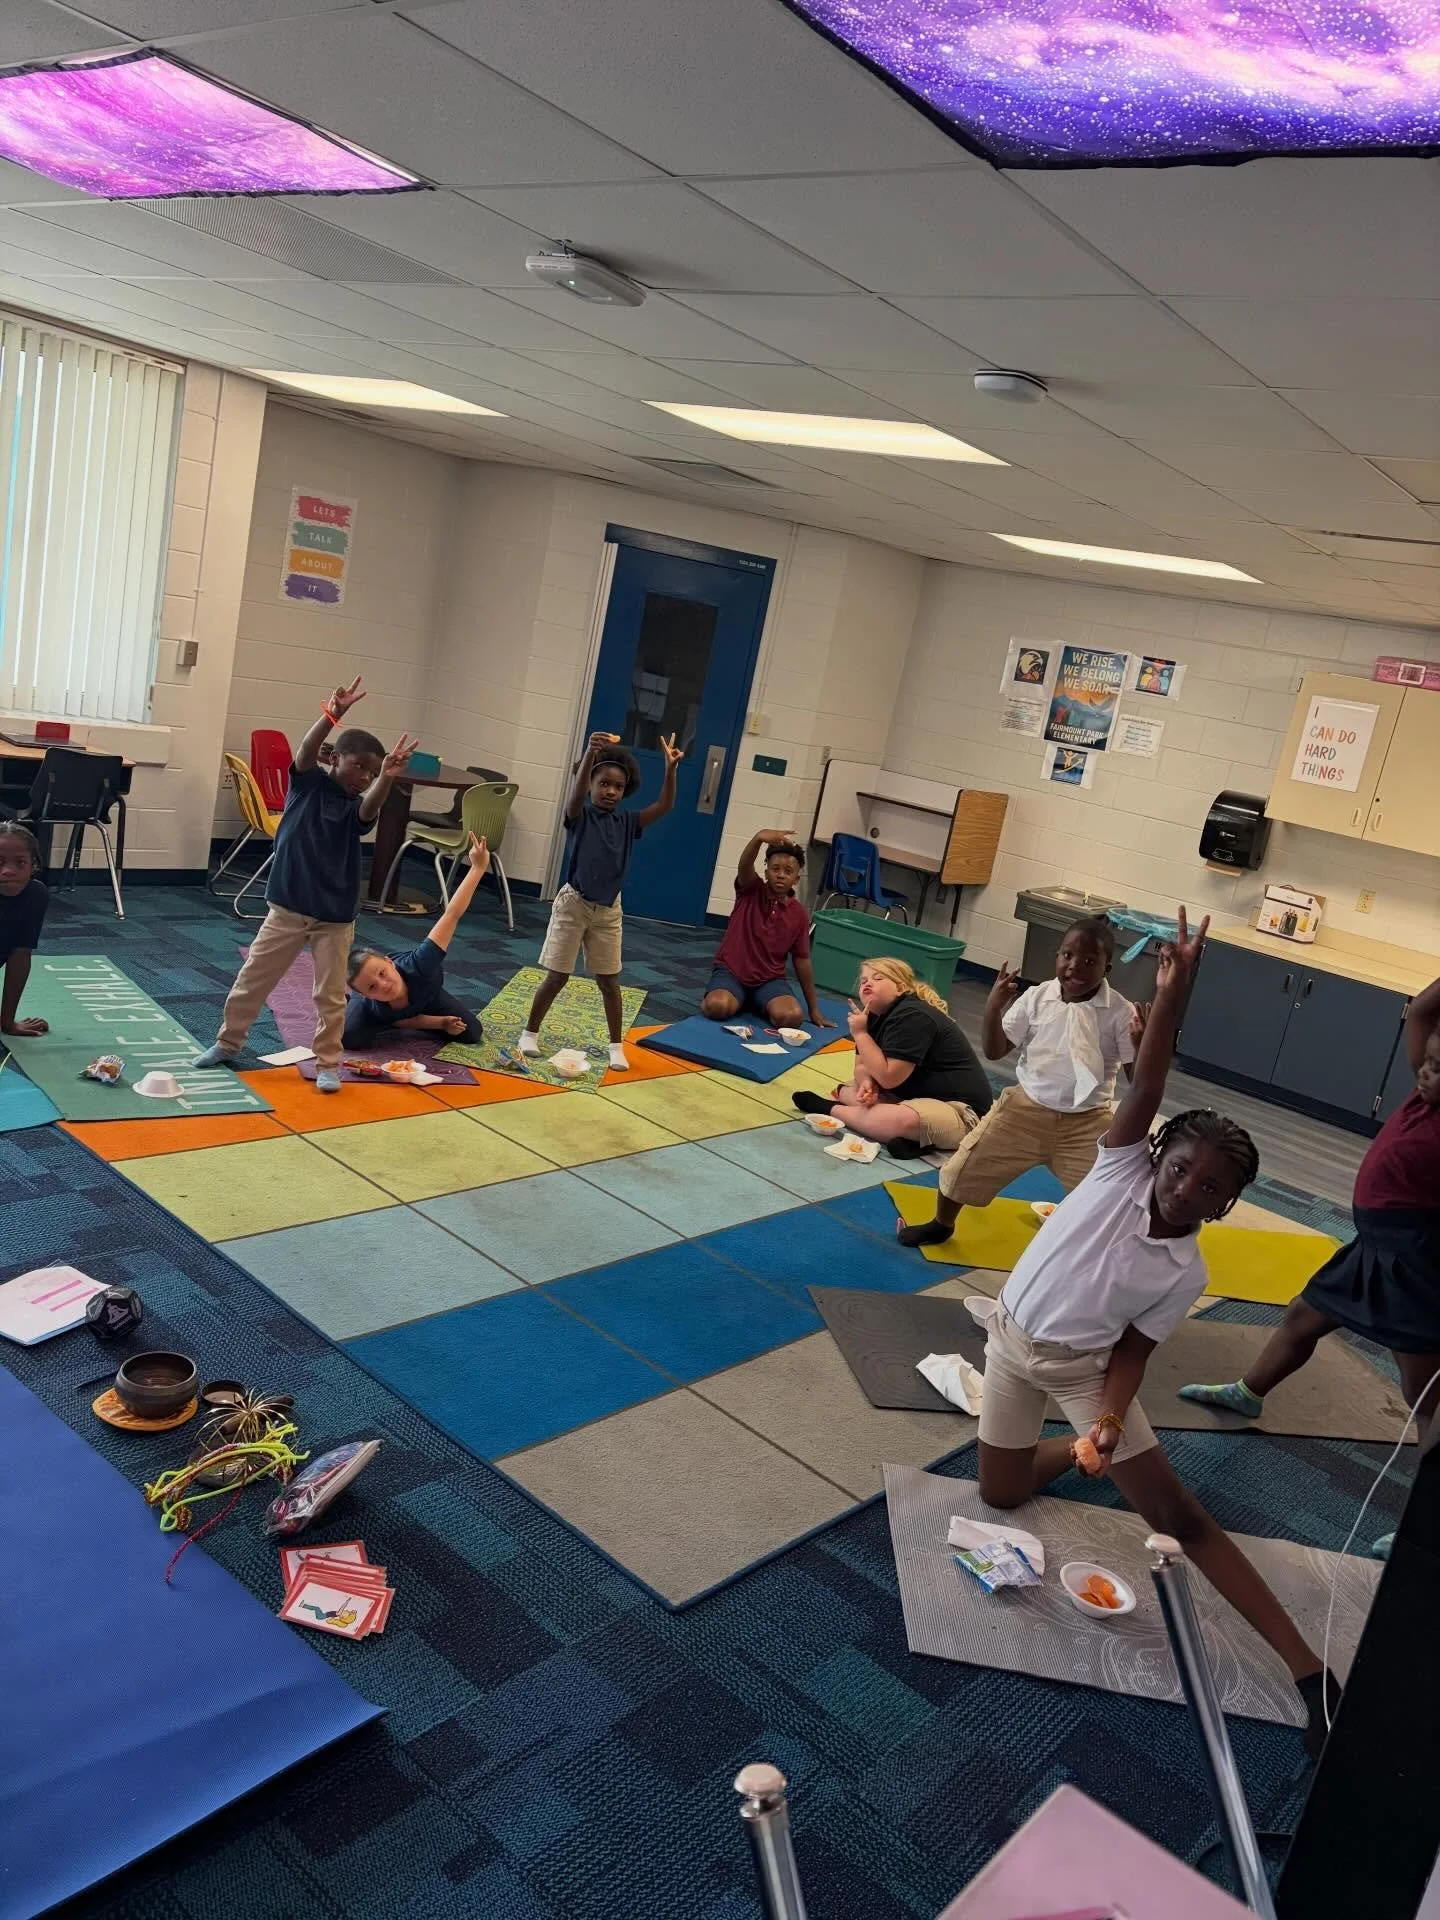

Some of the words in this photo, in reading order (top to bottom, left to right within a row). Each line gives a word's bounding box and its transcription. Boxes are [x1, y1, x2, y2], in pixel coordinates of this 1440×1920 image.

[309, 533, 333, 544] TALK
[301, 559, 333, 571] ABOUT
[308, 584, 317, 592] IT
[1072, 651, 1089, 665] WE
[1090, 655, 1117, 670] RISE.
[1063, 664, 1080, 677] WE
[1081, 667, 1121, 684] BELONG.
[1063, 677, 1080, 690] WE
[1315, 706, 1320, 718] I
[1050, 723, 1085, 736] FAIRMOUNT
[1086, 729, 1104, 739] PARK
[1052, 730, 1098, 745] ELEMENTARY
[1310, 726, 1334, 741] CAN
[1338, 730, 1356, 744] DO
[1304, 744, 1336, 760] HARD
[1301, 762, 1344, 781] THINGS
